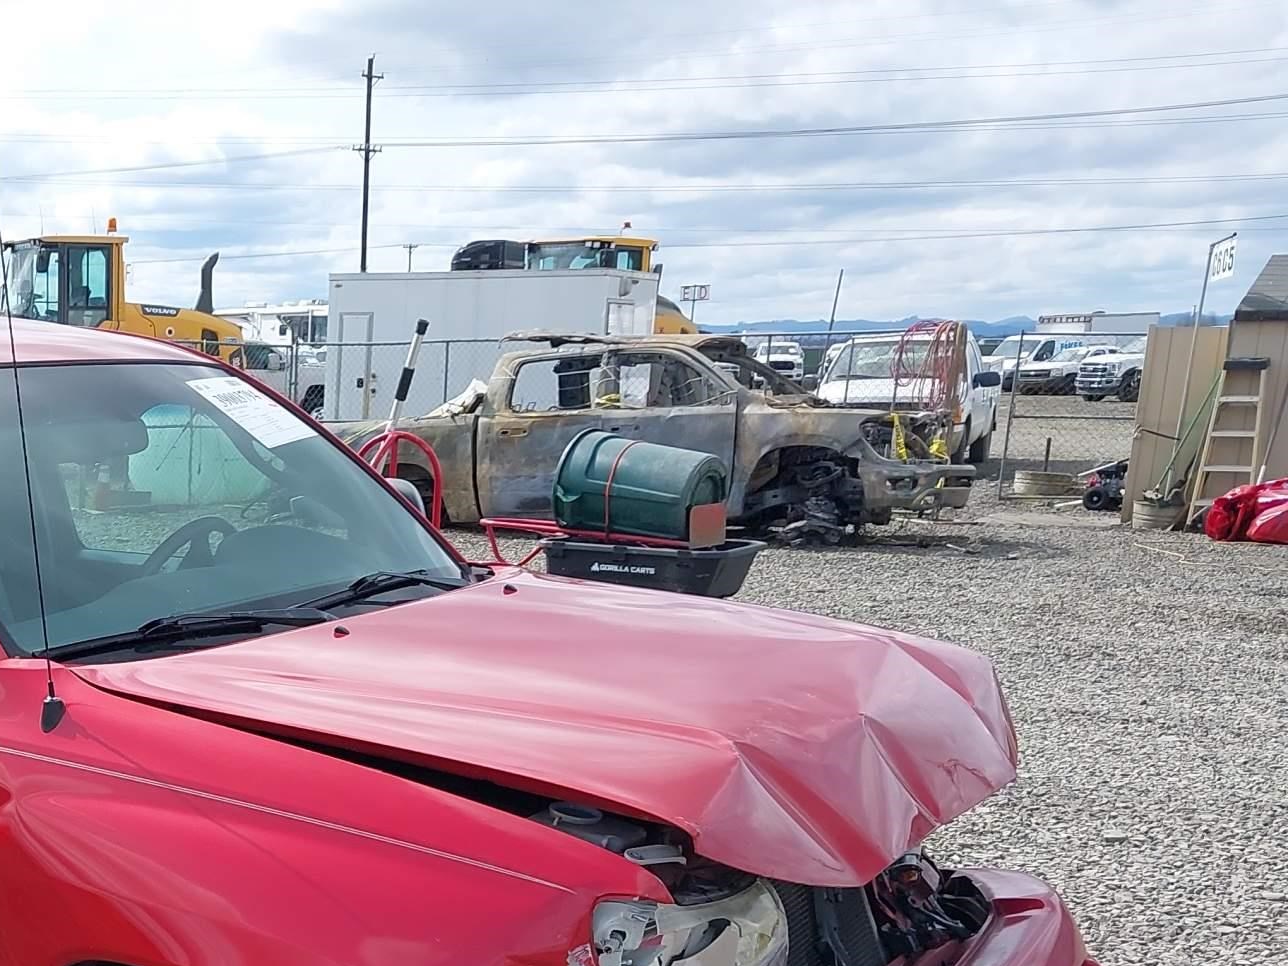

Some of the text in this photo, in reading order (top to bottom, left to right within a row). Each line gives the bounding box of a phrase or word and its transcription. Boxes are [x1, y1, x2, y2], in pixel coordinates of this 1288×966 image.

[144, 307, 177, 315] VOLVO
[599, 564, 656, 575] GORILLA CARTS
